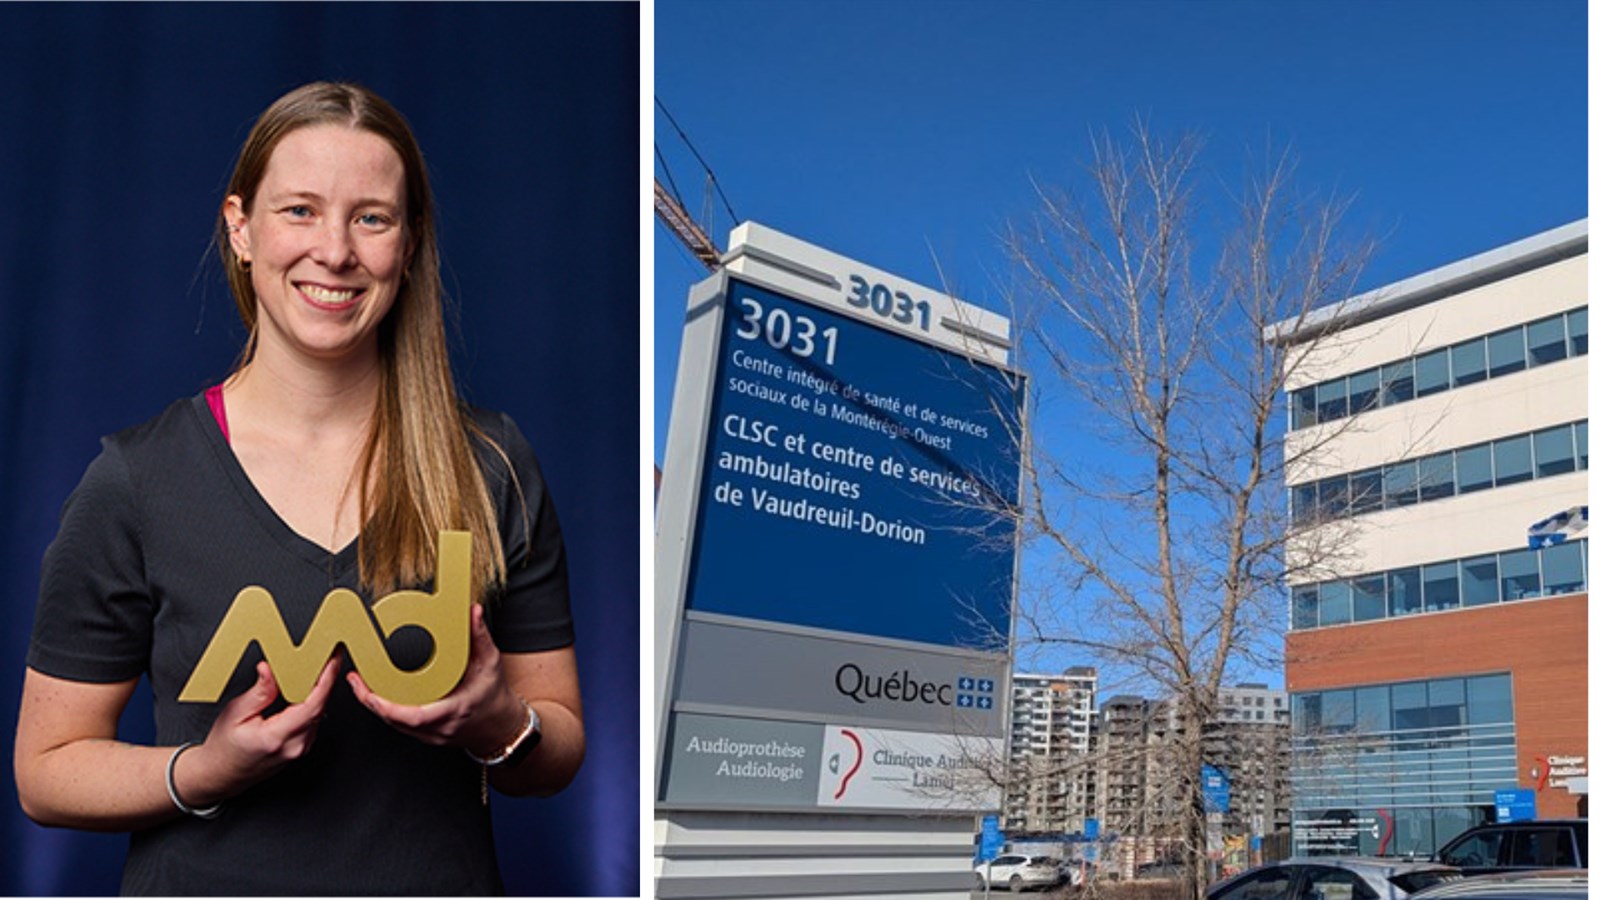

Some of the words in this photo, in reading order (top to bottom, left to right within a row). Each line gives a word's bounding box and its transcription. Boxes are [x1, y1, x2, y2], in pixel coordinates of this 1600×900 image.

[736, 297, 840, 366] 3031
[847, 273, 932, 332] 3031
[729, 377, 786, 405] sociaux
[791, 393, 811, 412] de
[813, 397, 828, 417] la
[831, 403, 952, 451] Montérégie-Ouest
[733, 350, 783, 379] Centre
[787, 364, 839, 396] intégré
[842, 383, 860, 401] de
[864, 390, 901, 413] santé
[904, 403, 918, 419] et
[921, 404, 937, 424] de
[940, 412, 989, 439] services
[719, 451, 861, 500] ambulatoires
[723, 413, 779, 448] CLSC
[784, 432, 806, 455] et
[811, 440, 875, 472] centre
[880, 455, 904, 479] de
[909, 467, 981, 499] services
[714, 481, 744, 507] de
[751, 487, 927, 545] Vaudreuil-Dorion
[835, 663, 952, 706] Québec
[686, 735, 806, 758] Audioprothèse
[715, 759, 804, 781] Audiologie
[873, 749, 934, 769] Clinique
